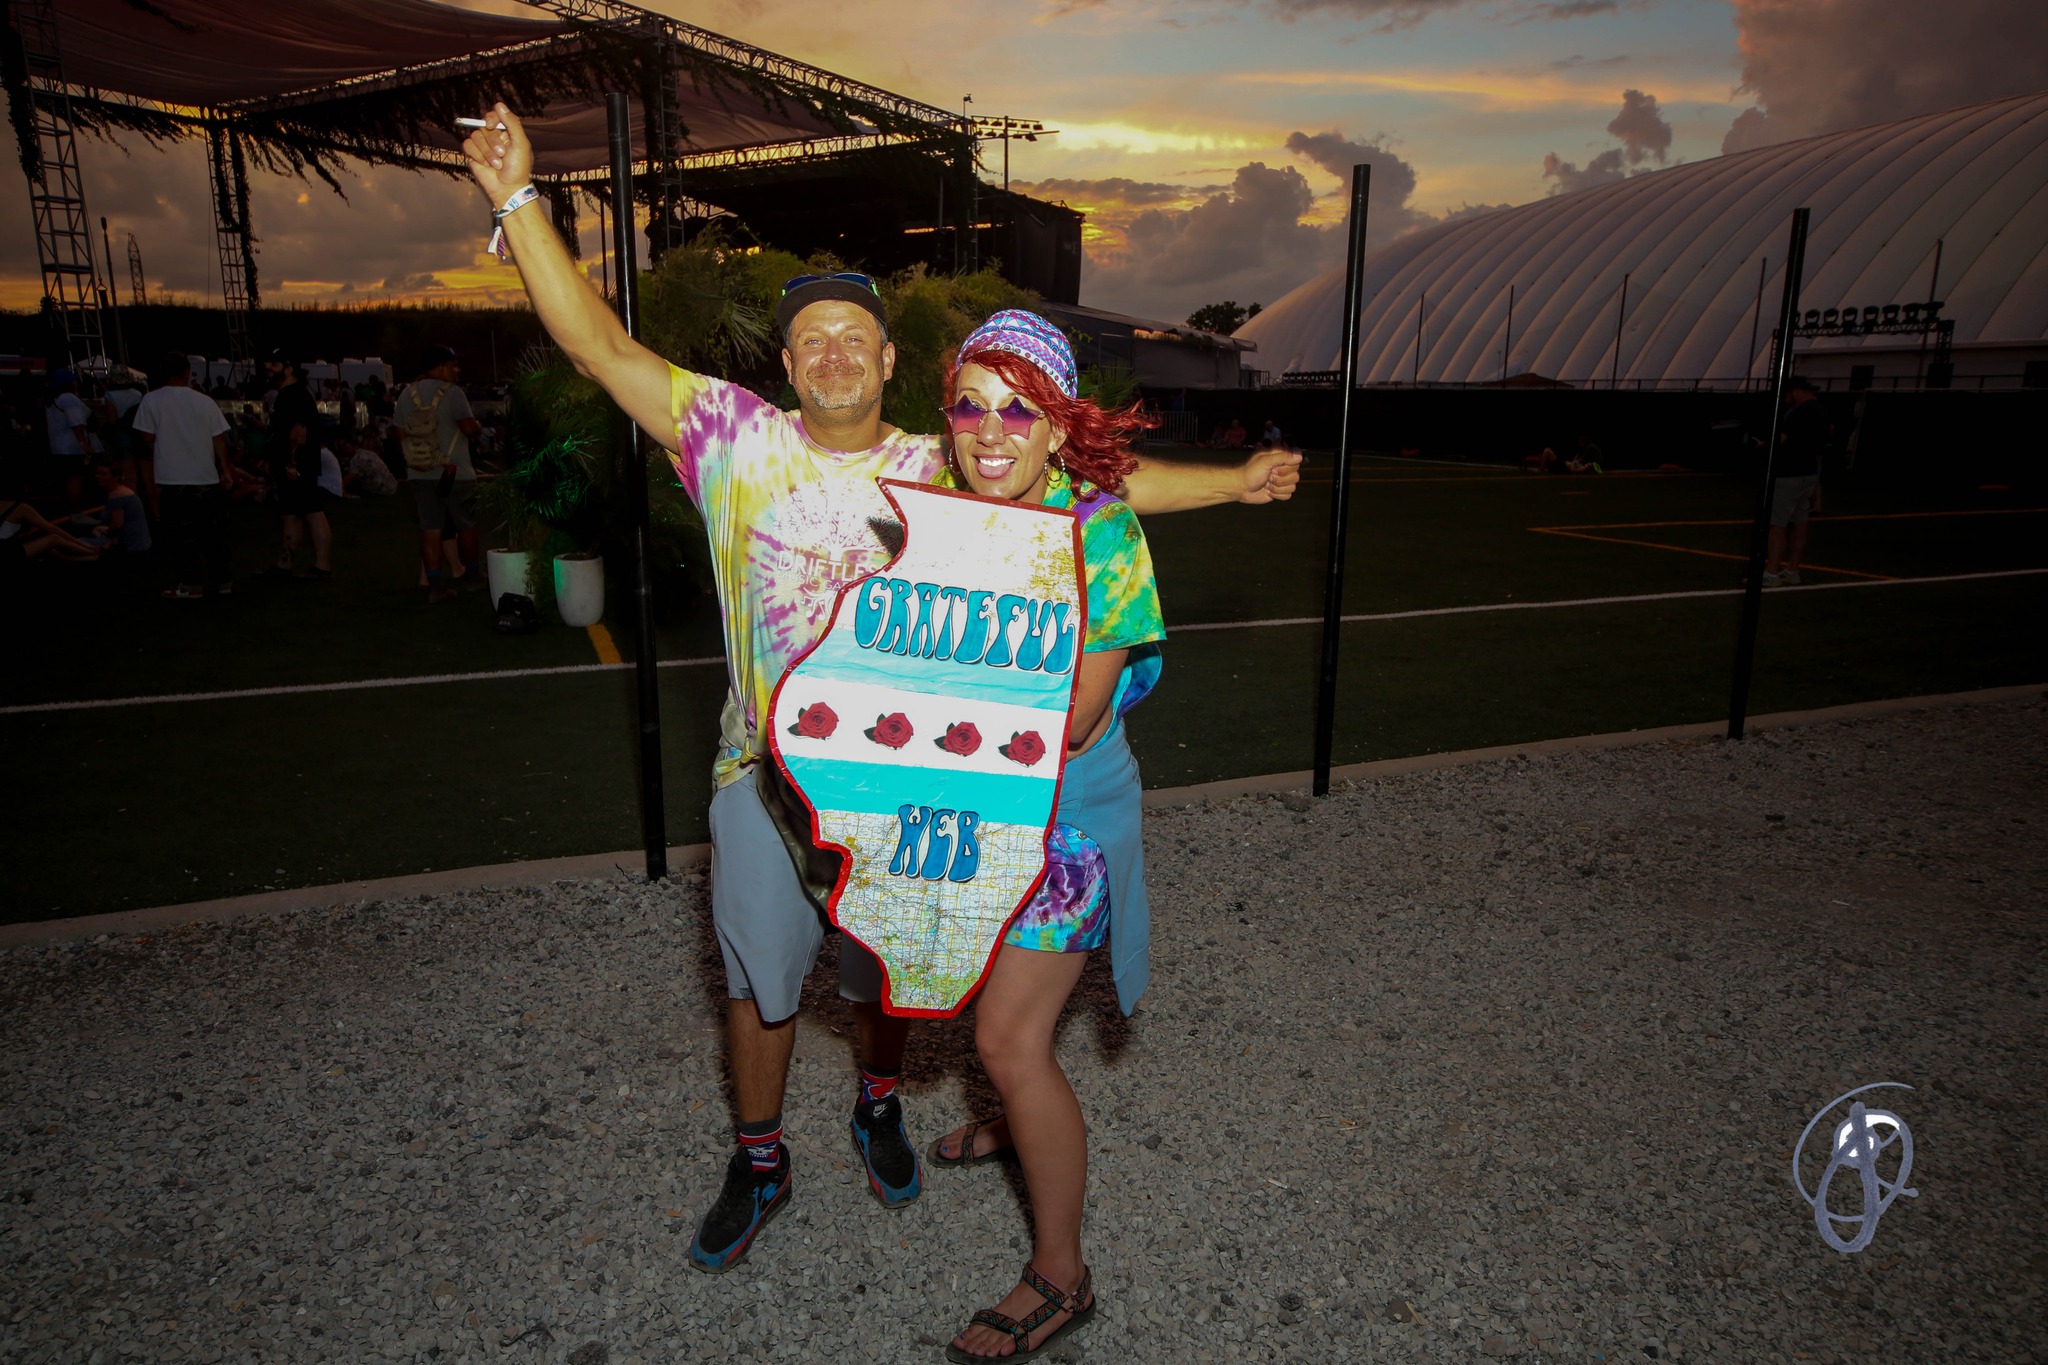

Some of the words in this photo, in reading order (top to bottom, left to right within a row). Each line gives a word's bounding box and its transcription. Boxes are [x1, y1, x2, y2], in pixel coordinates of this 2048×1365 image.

[777, 571, 819, 587] MUSIC
[854, 576, 1077, 675] GRATEFUL
[888, 803, 981, 883] WEB
